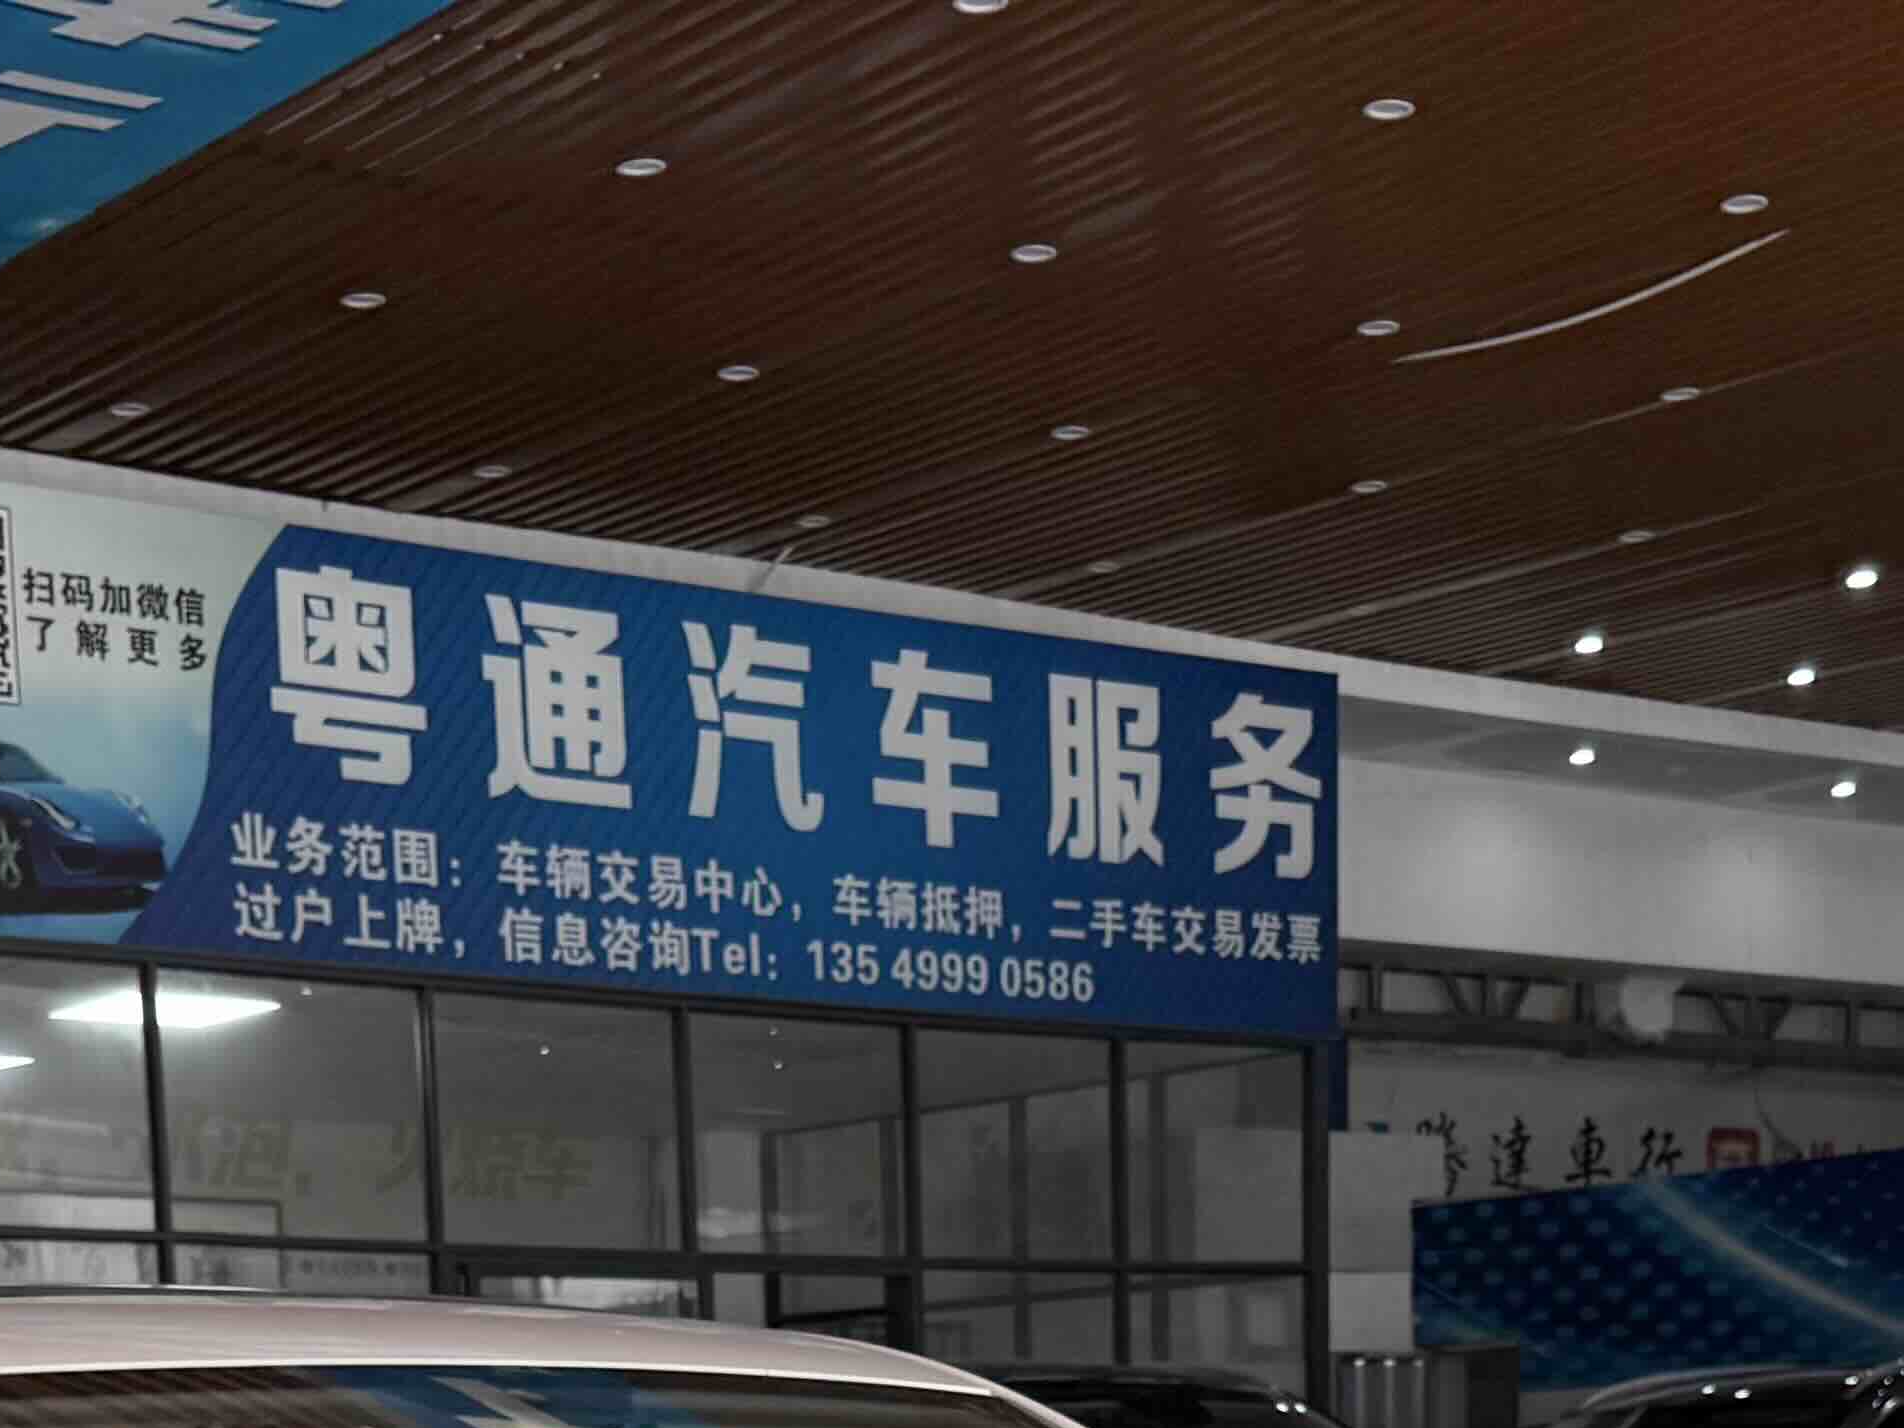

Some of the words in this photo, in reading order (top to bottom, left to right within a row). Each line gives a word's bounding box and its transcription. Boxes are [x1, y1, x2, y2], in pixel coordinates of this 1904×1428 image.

[21, 567, 207, 627] 扫码加微信
[25, 615, 210, 672] 了解更多
[270, 565, 1322, 880] 粤通汽车服务
